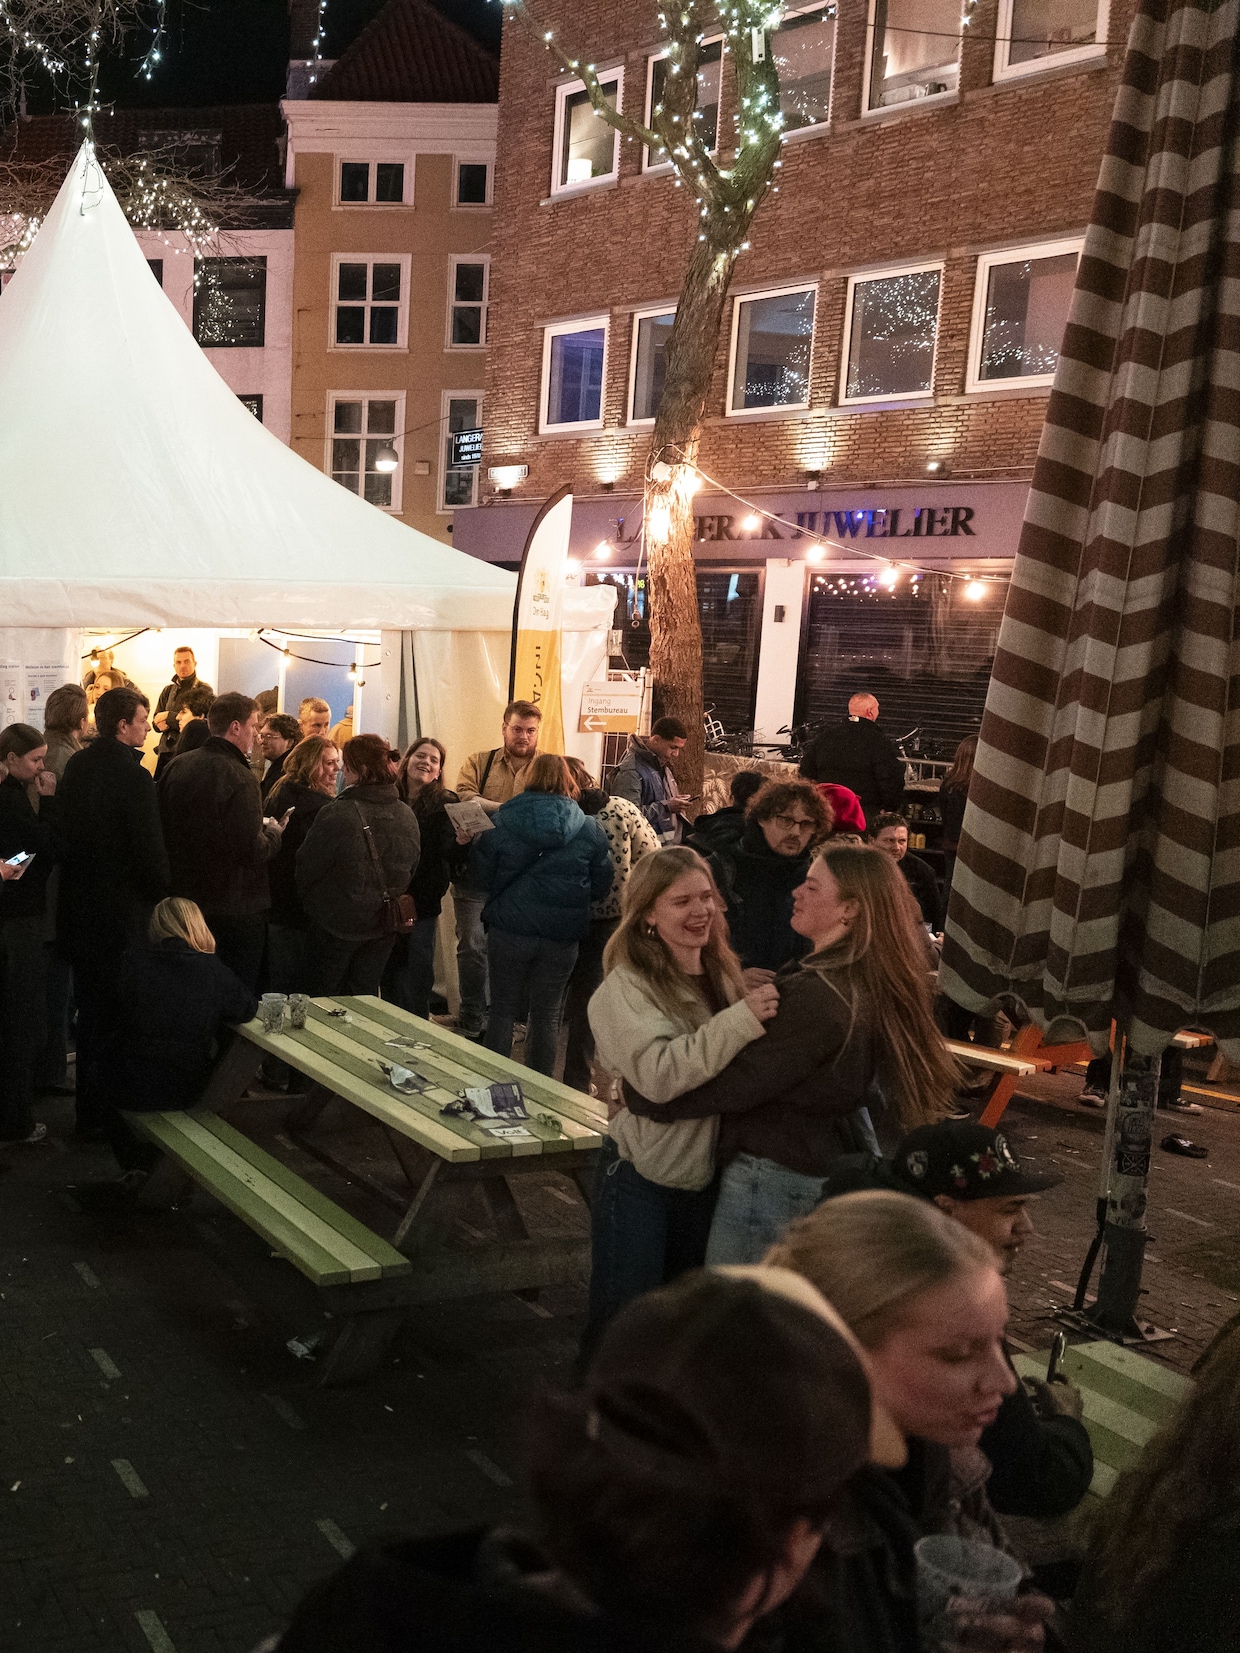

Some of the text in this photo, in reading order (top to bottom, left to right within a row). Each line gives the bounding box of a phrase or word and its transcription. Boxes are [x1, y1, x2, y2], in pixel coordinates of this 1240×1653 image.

[794, 506, 975, 540] JUWELIER
[588, 697, 611, 706] Ingang
[587, 706, 628, 714] Stembureau
